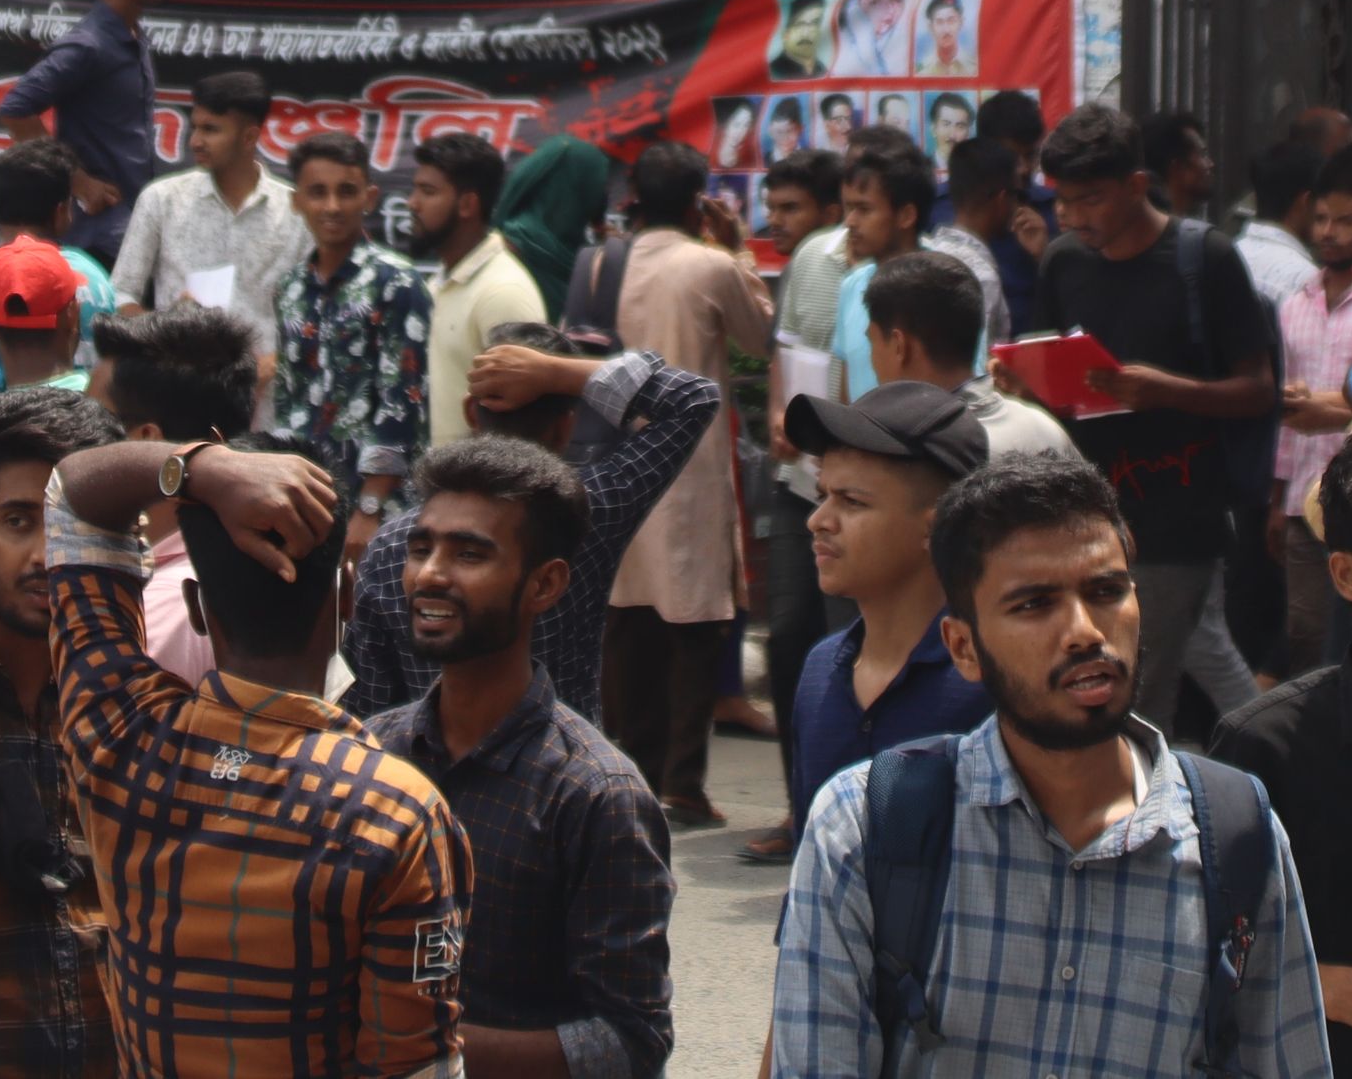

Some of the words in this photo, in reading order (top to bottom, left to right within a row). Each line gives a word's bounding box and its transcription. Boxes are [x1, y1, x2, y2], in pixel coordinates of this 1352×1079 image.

[182, 23, 216, 59] ৪৭
[221, 24, 257, 60] তম
[602, 23, 669, 64] ২০২২
